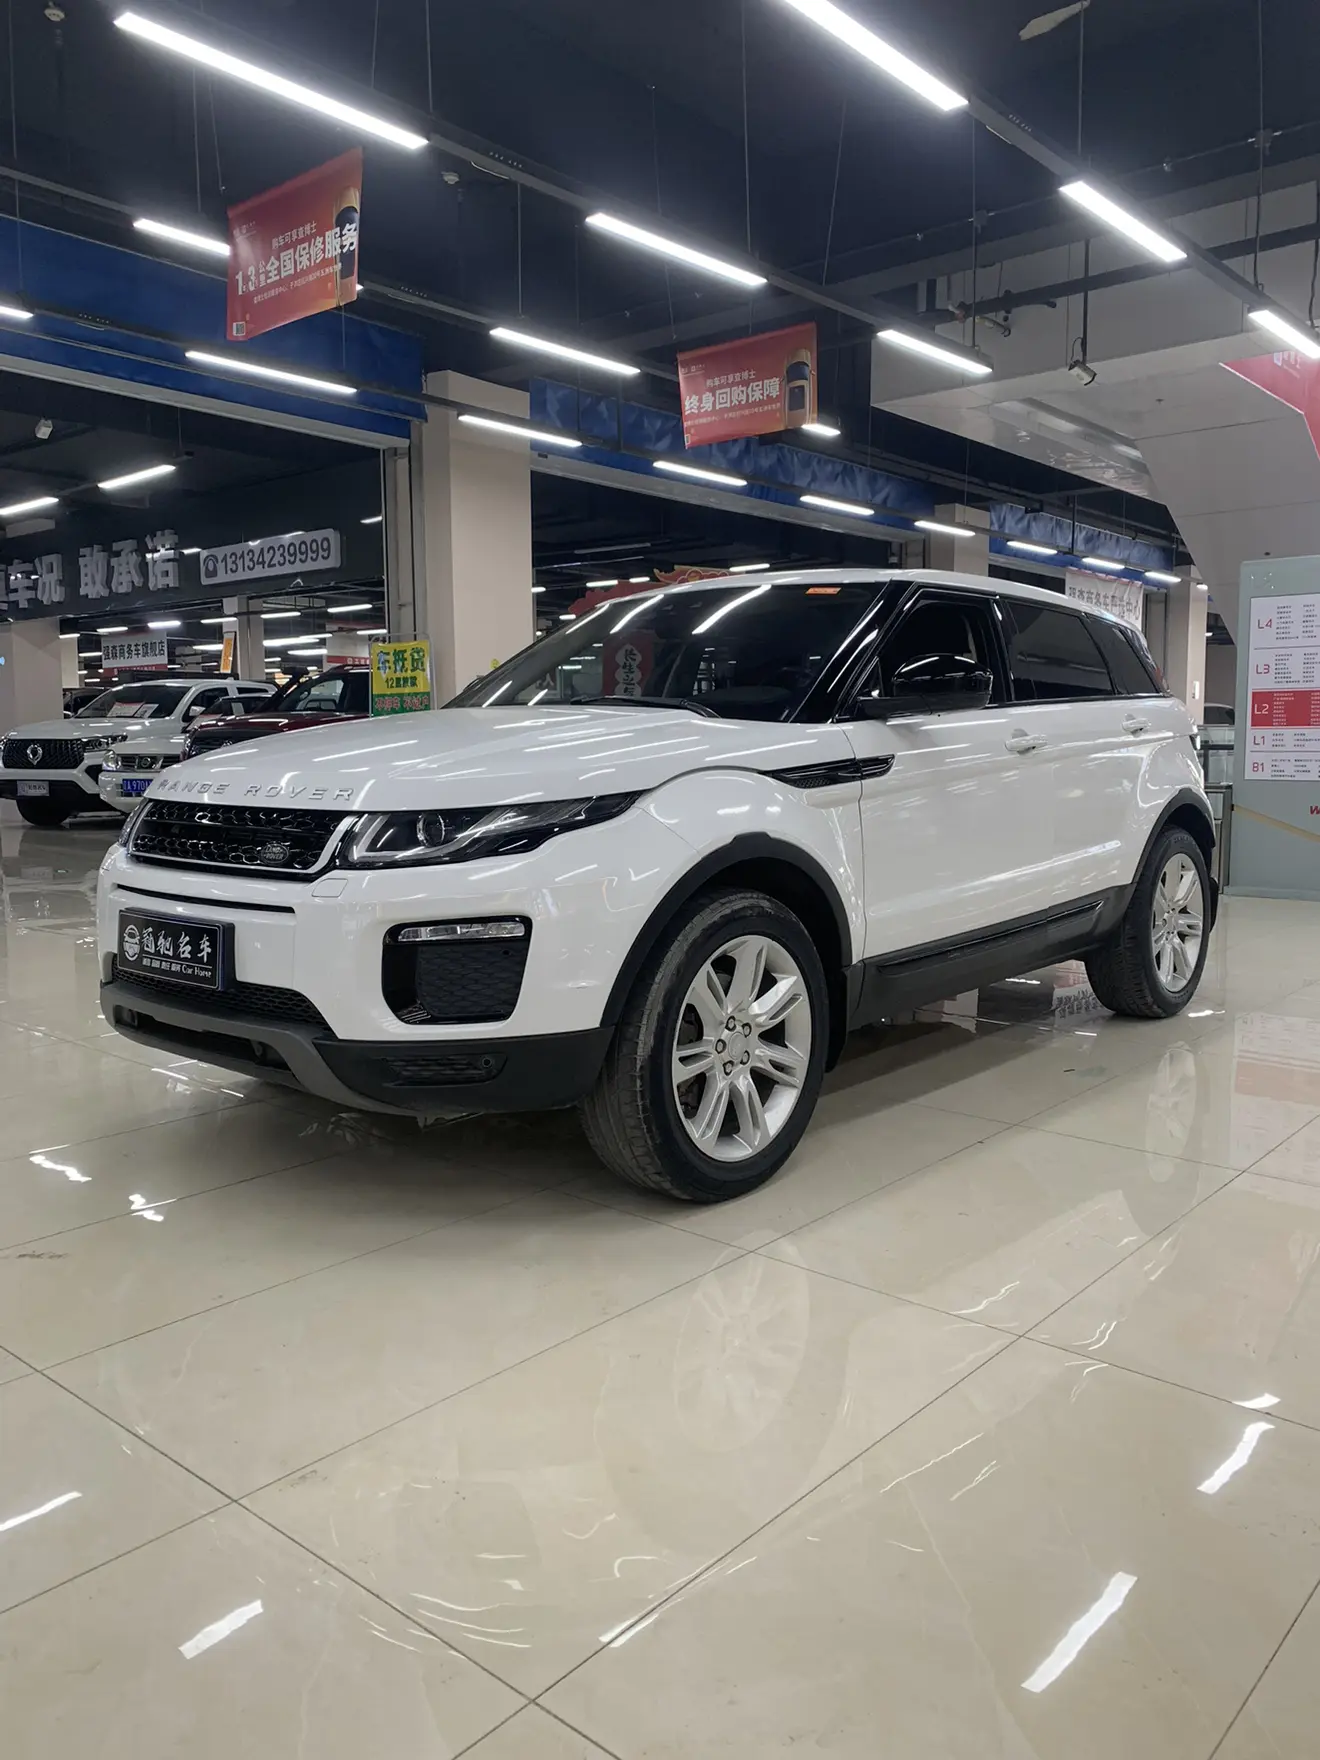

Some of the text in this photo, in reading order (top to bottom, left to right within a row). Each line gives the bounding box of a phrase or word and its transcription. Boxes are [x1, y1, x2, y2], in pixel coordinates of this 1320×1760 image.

[684, 377, 781, 416] 终身回购保障
[221, 535, 332, 577] 13134239999
[0, 529, 180, 611] 车况 敢承诺
[1257, 617, 1273, 630] L4
[1255, 663, 1271, 675] L3
[1254, 703, 1270, 715] L2
[1252, 735, 1266, 746] L1
[1251, 761, 1265, 773] B1
[244, 784, 355, 801] ROVER
